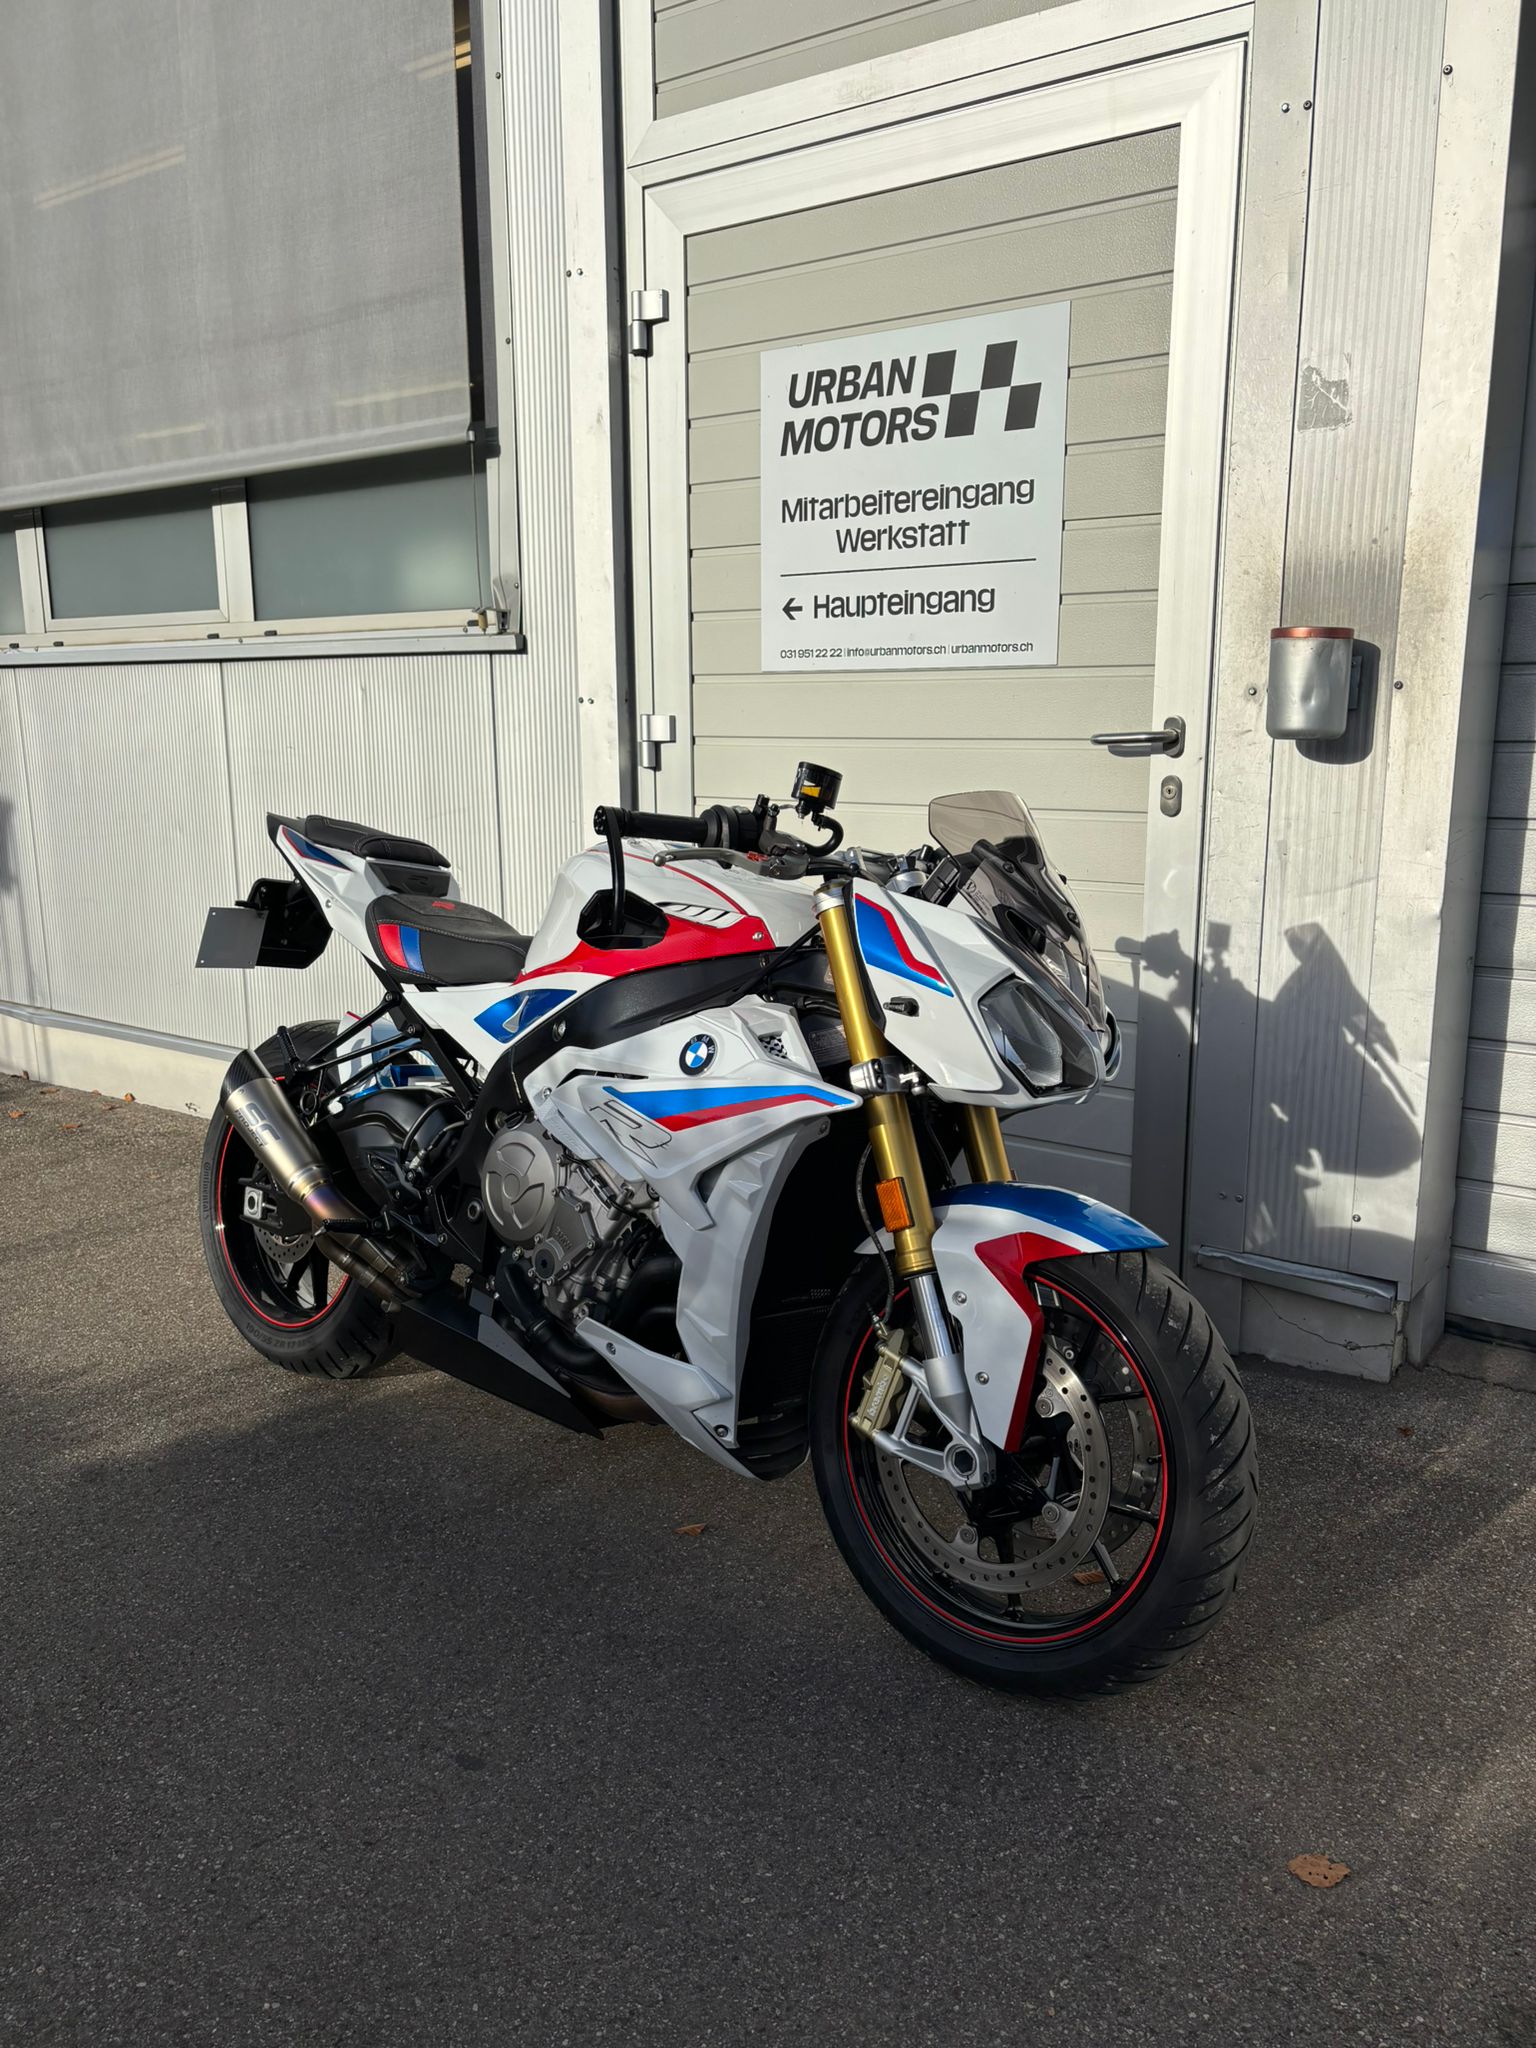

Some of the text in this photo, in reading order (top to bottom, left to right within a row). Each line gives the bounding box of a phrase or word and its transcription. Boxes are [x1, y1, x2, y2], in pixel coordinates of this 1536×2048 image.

[788, 355, 917, 409] URBAN
[780, 403, 940, 457] MOTORS
[781, 478, 1035, 523] Mitarbeitereingang
[836, 519, 970, 553] Werkstatt
[813, 587, 995, 619] Haupteingang
[951, 641, 1034, 655] urbanmotors.ch
[690, 1034, 715, 1054] BMW
